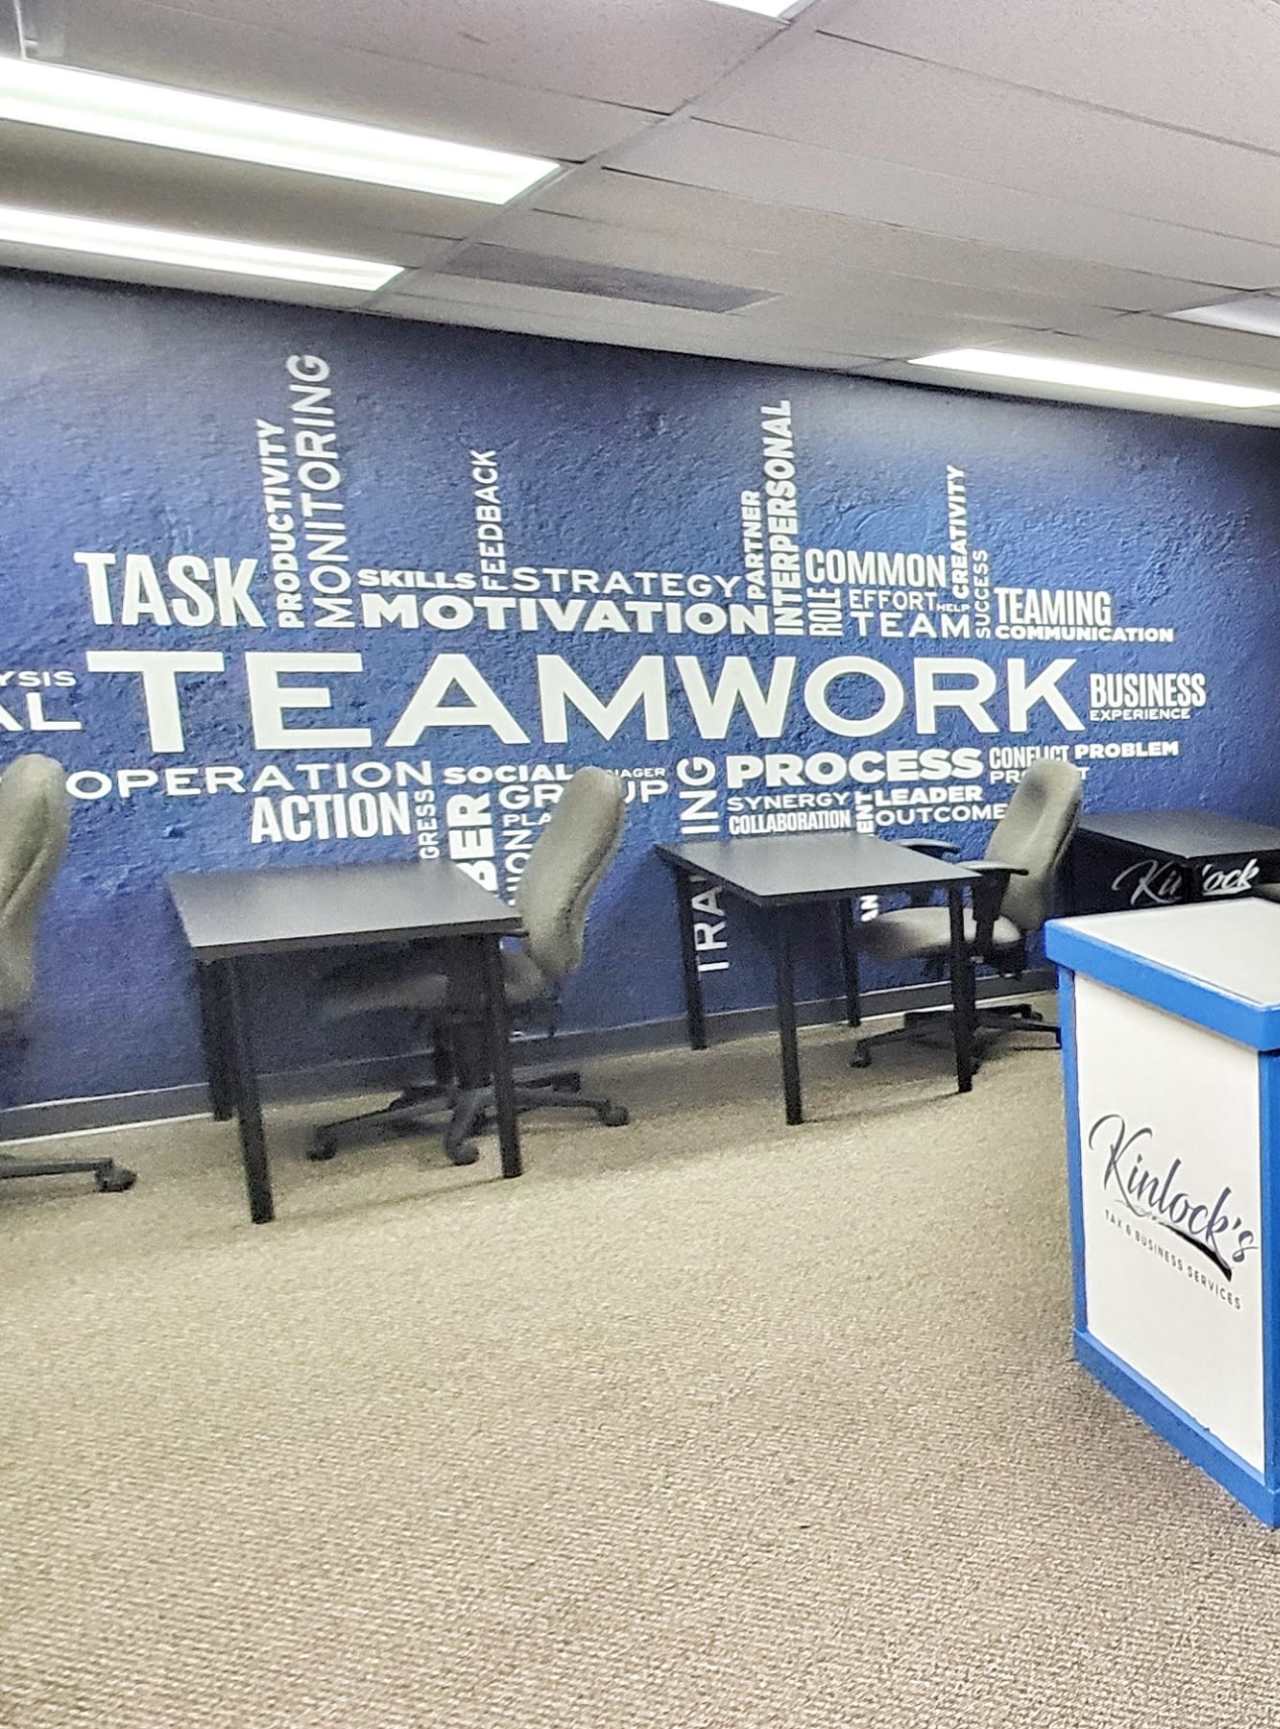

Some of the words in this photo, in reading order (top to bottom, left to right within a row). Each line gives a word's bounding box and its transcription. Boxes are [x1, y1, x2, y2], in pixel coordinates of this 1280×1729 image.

[286, 354, 356, 629] MONITORING
[256, 418, 305, 628] PRODUCTIVITY
[470, 449, 510, 592] FEEDBACK
[760, 399, 805, 637] INTERPERSONAL
[945, 464, 970, 600] CREATIVITY
[740, 489, 768, 600] PARTNER
[357, 569, 477, 590] SKILLS
[512, 566, 744, 599] STRATEGY
[804, 547, 947, 589] COMMON
[74, 551, 266, 628] TASK
[848, 589, 938, 613] EFFORT
[936, 603, 971, 612] HELP
[973, 548, 991, 639] SUCCESS
[994, 587, 1112, 627] TEAMING
[360, 593, 770, 635] MOTIVATION
[808, 587, 844, 637] ROLE
[851, 613, 971, 639] TEAM
[994, 625, 1174, 643] COMMUNICATION
[86, 650, 1086, 757] TEAMWORK
[1090, 673, 1206, 707] BUSINESS
[1090, 708, 1191, 721] EXPERIENCE
[726, 747, 984, 789] PROCESS
[1074, 740, 1179, 760] PROBLEM
[443, 764, 573, 785] SOCIAL
[250, 790, 411, 844] ACTION
[727, 792, 849, 812] SYNERGY
[875, 785, 983, 807] LEADER
[728, 809, 852, 835] COLLABORATION
[1089, 1114, 1258, 1264] Kinlock's
[1105, 1209, 1122, 1228] TAX
[1135, 1231, 1183, 1271] BUSINESS
[1188, 1266, 1240, 1310] SERVICES
